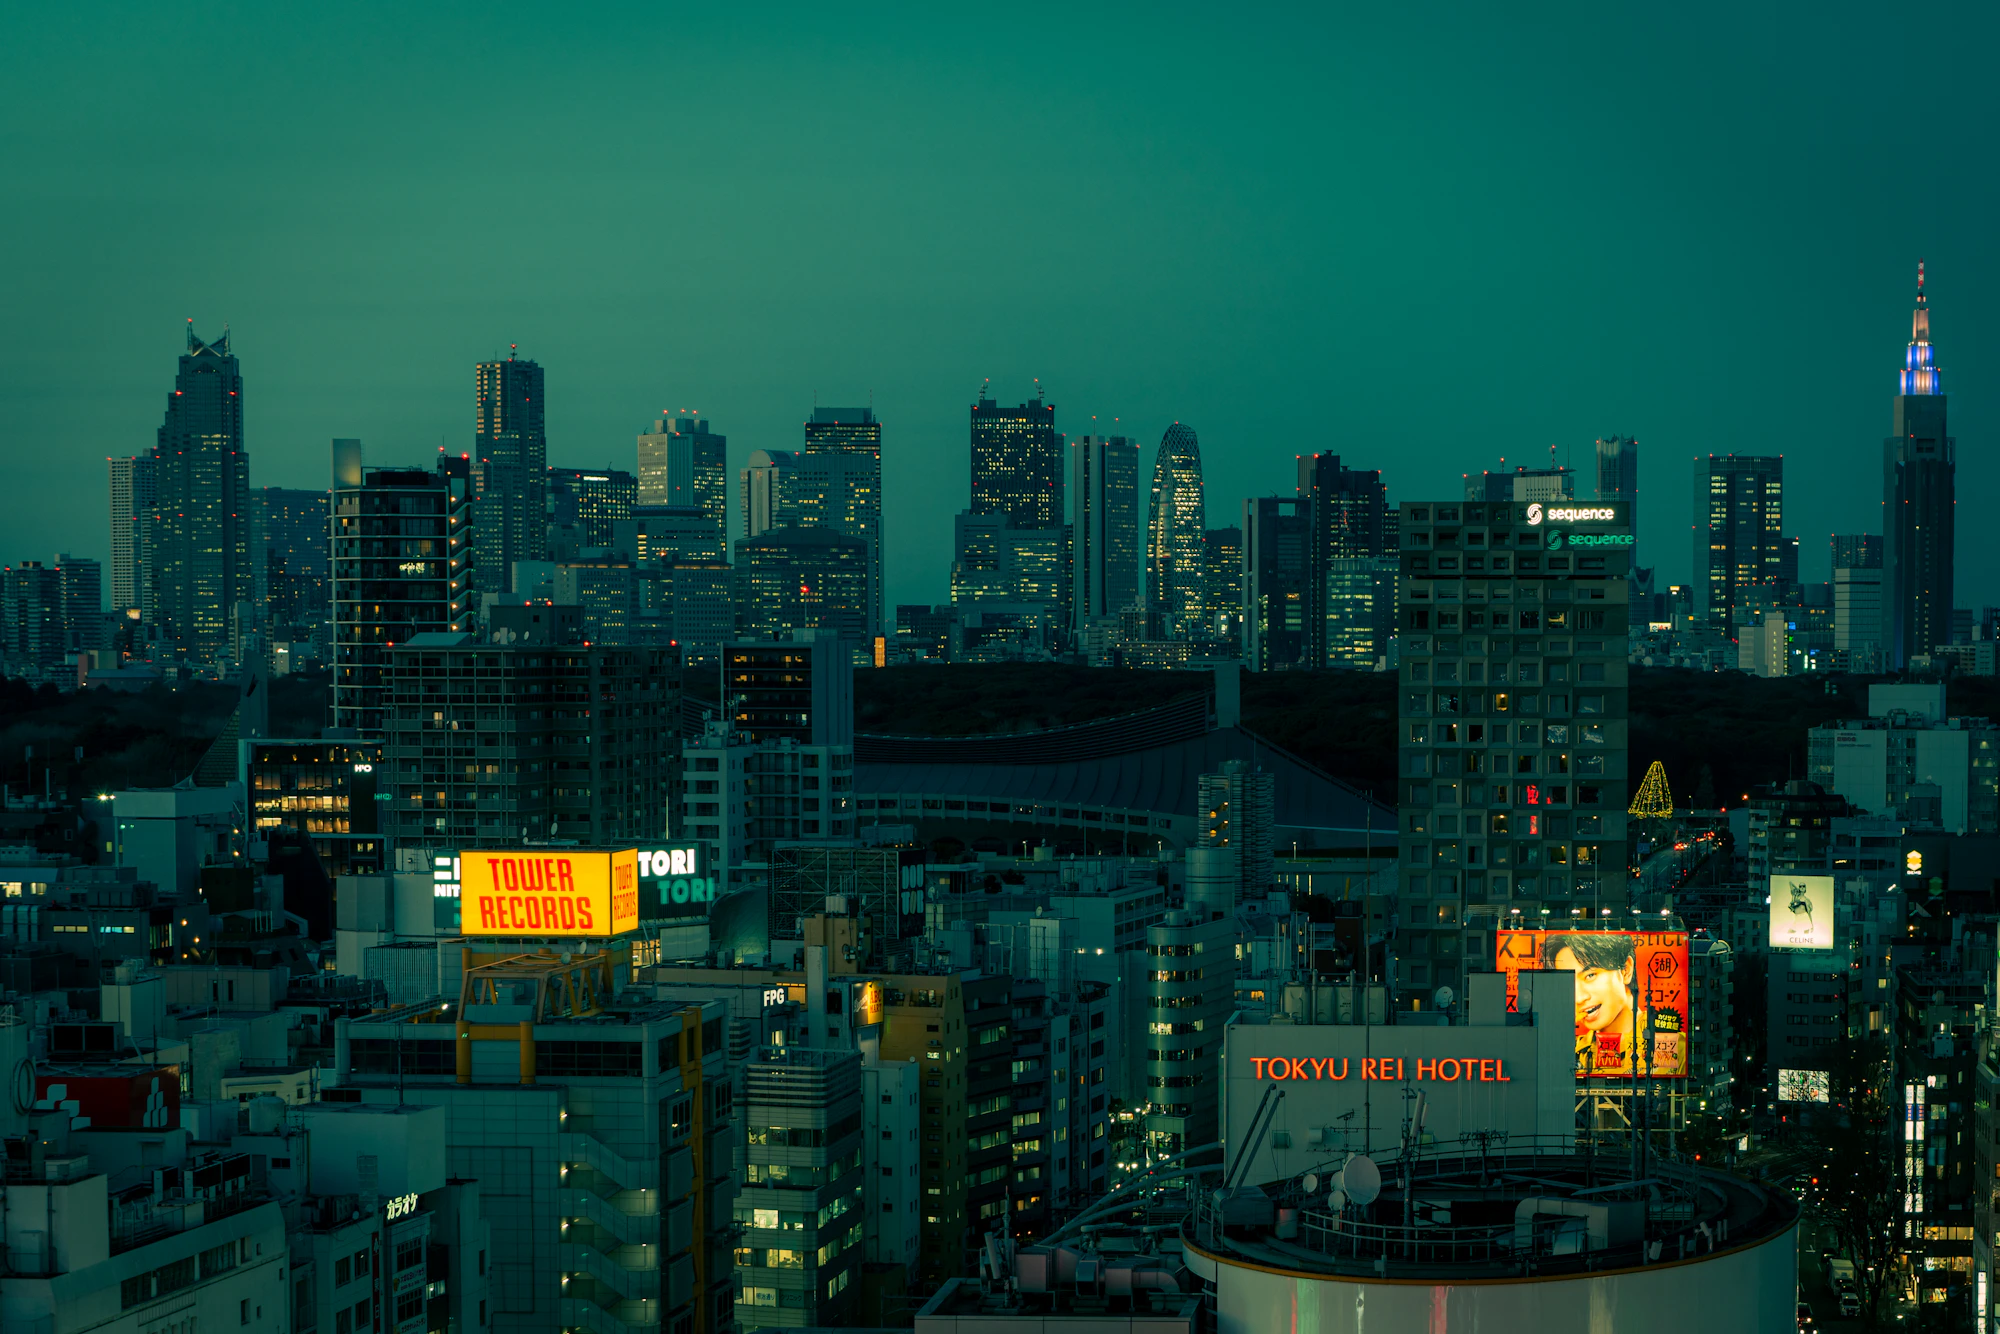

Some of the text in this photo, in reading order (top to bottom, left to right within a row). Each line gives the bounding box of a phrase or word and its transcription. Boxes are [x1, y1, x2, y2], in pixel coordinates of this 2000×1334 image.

[1548, 508, 1614, 522] sequence
[1569, 534, 1634, 546] sequence
[487, 858, 574, 892] TOWER
[638, 849, 695, 877] TORI
[615, 863, 633, 891] TOWER
[479, 896, 593, 929] RECORDS
[613, 891, 636, 921] RECORDS
[1654, 958, 1671, 973] 湖
[763, 988, 784, 1007] FPG
[869, 1004, 881, 1014] MART
[870, 990, 881, 1004] ABC
[1250, 1057, 1511, 1081] TOKYU REI HOTEL
[387, 1192, 418, 1220] カラオケ
